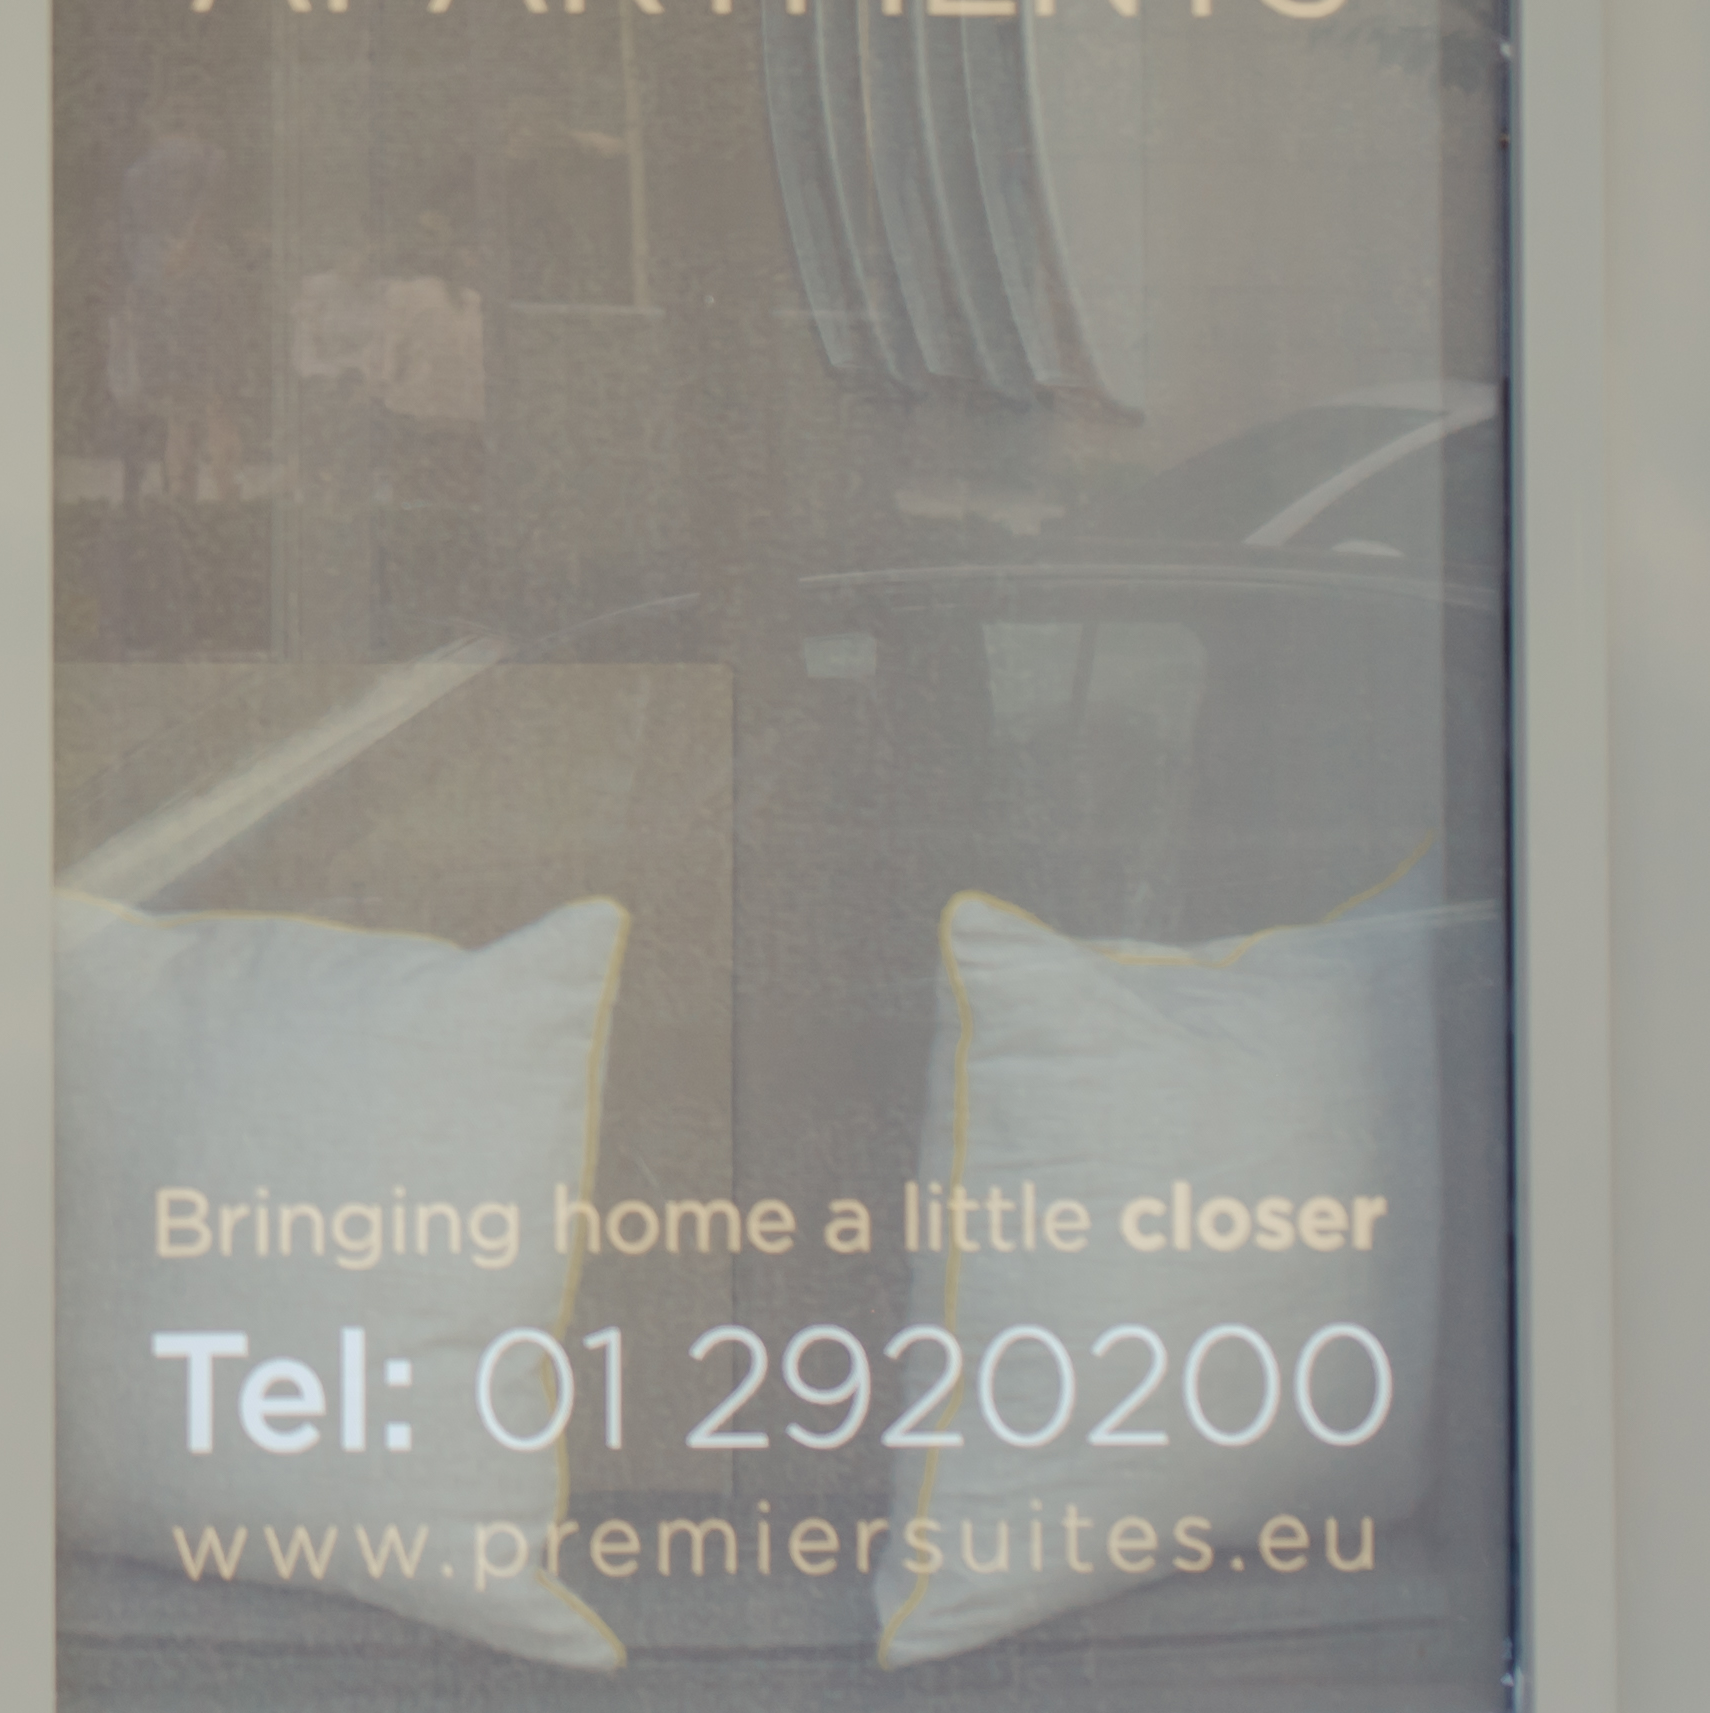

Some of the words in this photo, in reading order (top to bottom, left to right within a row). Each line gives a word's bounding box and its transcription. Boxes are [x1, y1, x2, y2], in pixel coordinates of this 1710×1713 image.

[153, 1181, 520, 1271] Bringing
[552, 1183, 796, 1255] home
[823, 1197, 873, 1254] a
[905, 1179, 1091, 1254] little
[1118, 1181, 1389, 1253] closer
[151, 1326, 414, 1457] Tel:
[475, 1325, 626, 1452] 01
[684, 1321, 1396, 1451] 2920200
[171, 1499, 1376, 1592] www.premiersuites.eu
